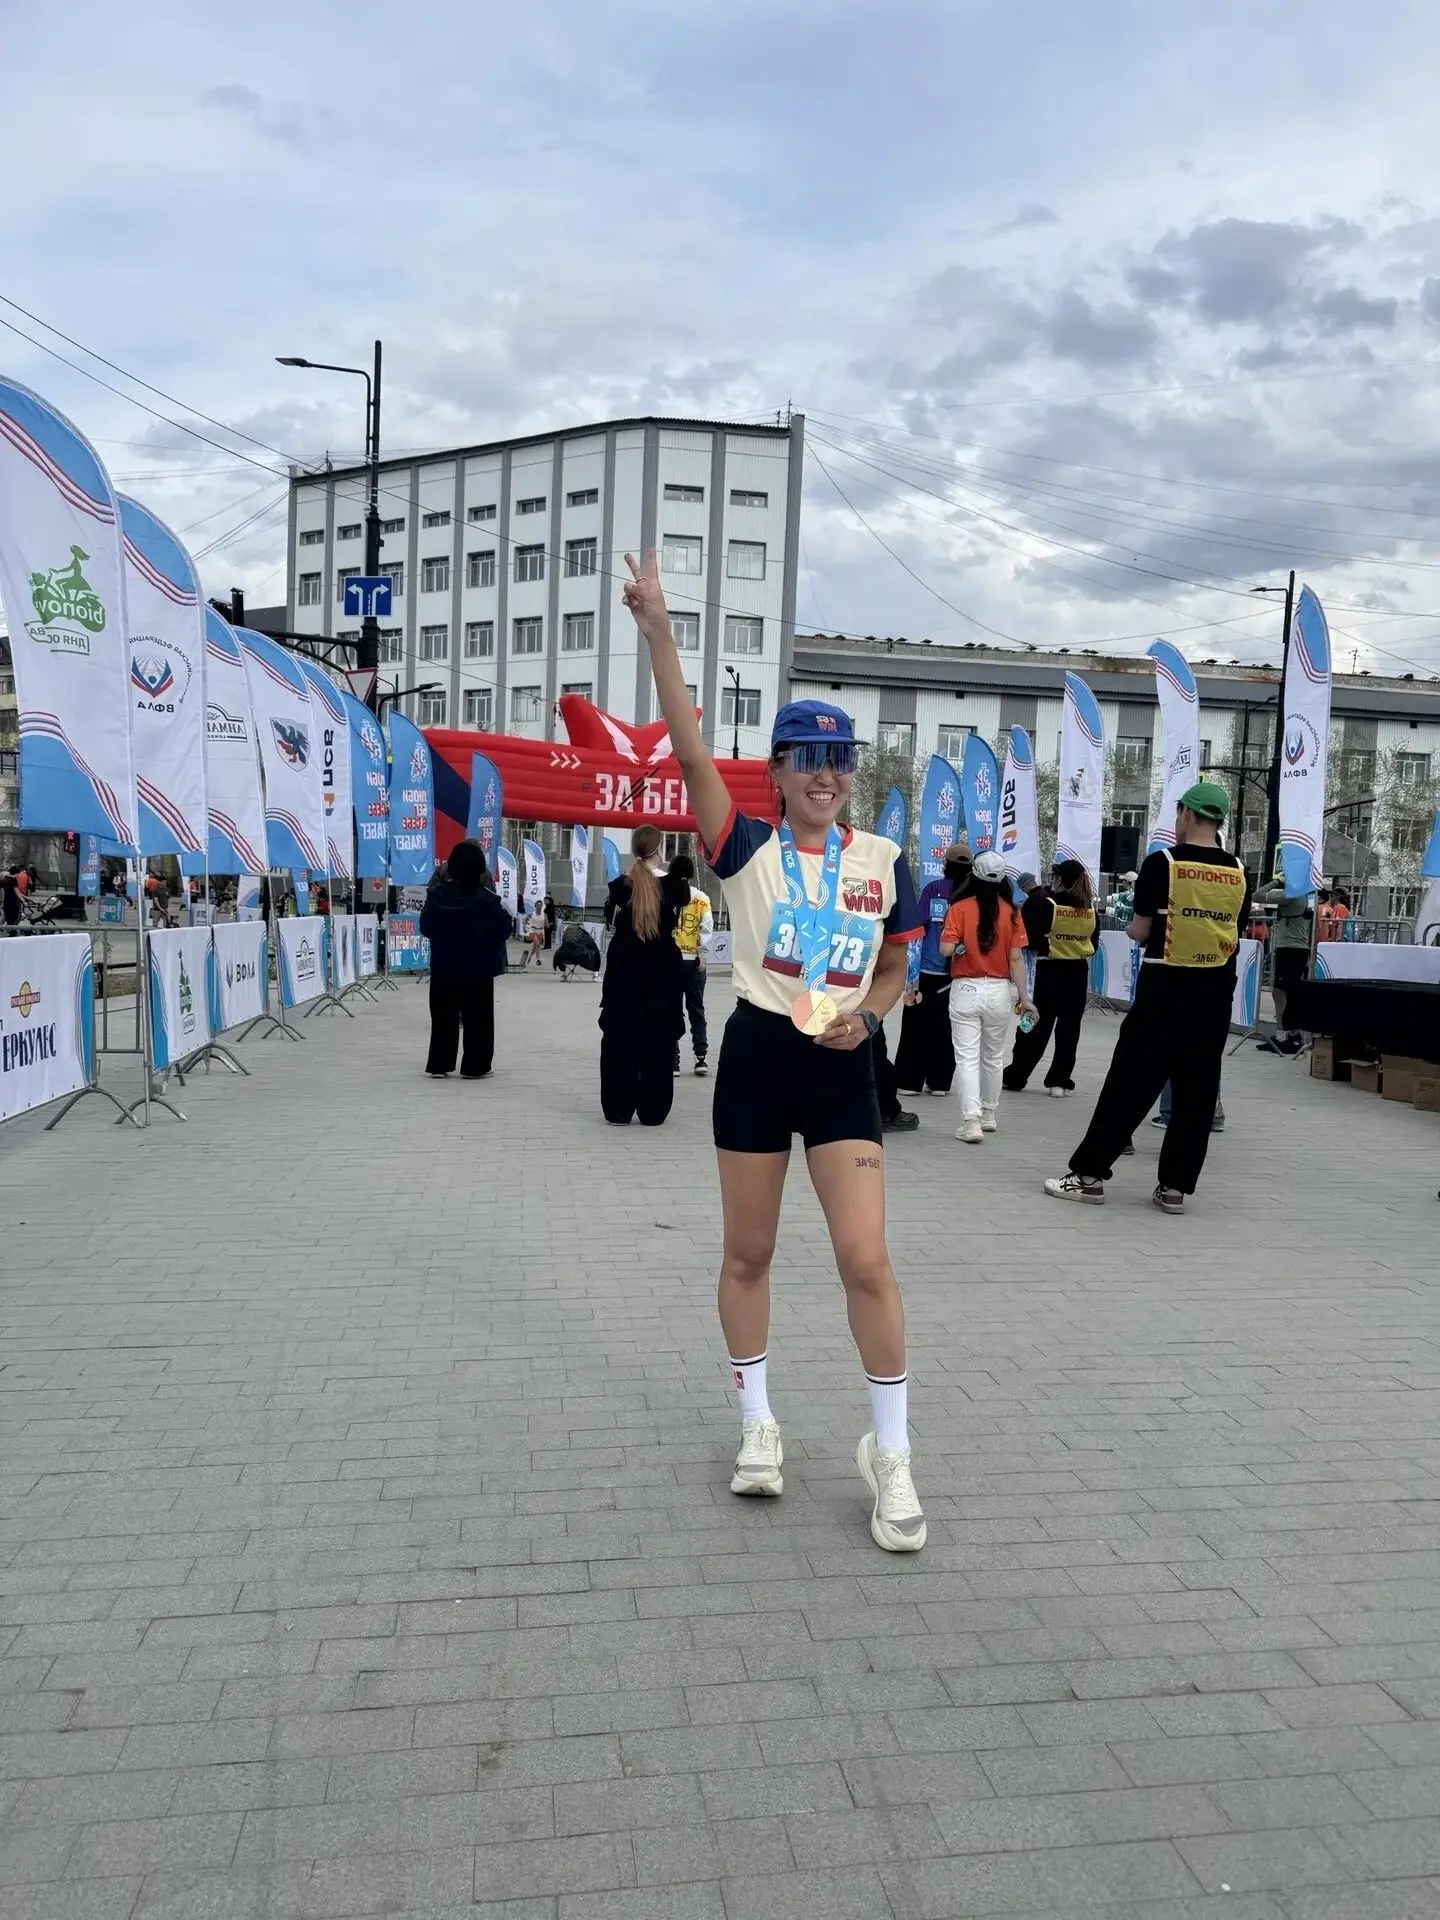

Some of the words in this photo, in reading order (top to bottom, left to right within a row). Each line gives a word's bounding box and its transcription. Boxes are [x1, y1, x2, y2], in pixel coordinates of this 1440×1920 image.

[594, 772, 634, 813] ЗА
[783, 850, 796, 869] ПСБ
[828, 844, 838, 861] ПСБ
[1176, 867, 1242, 886] ВОЛОНТЕР
[842, 892, 883, 915] WIN
[1181, 907, 1232, 923] ОТВЕЧАЮ
[0, 1019, 57, 1073] ЕРКУЛЕС
